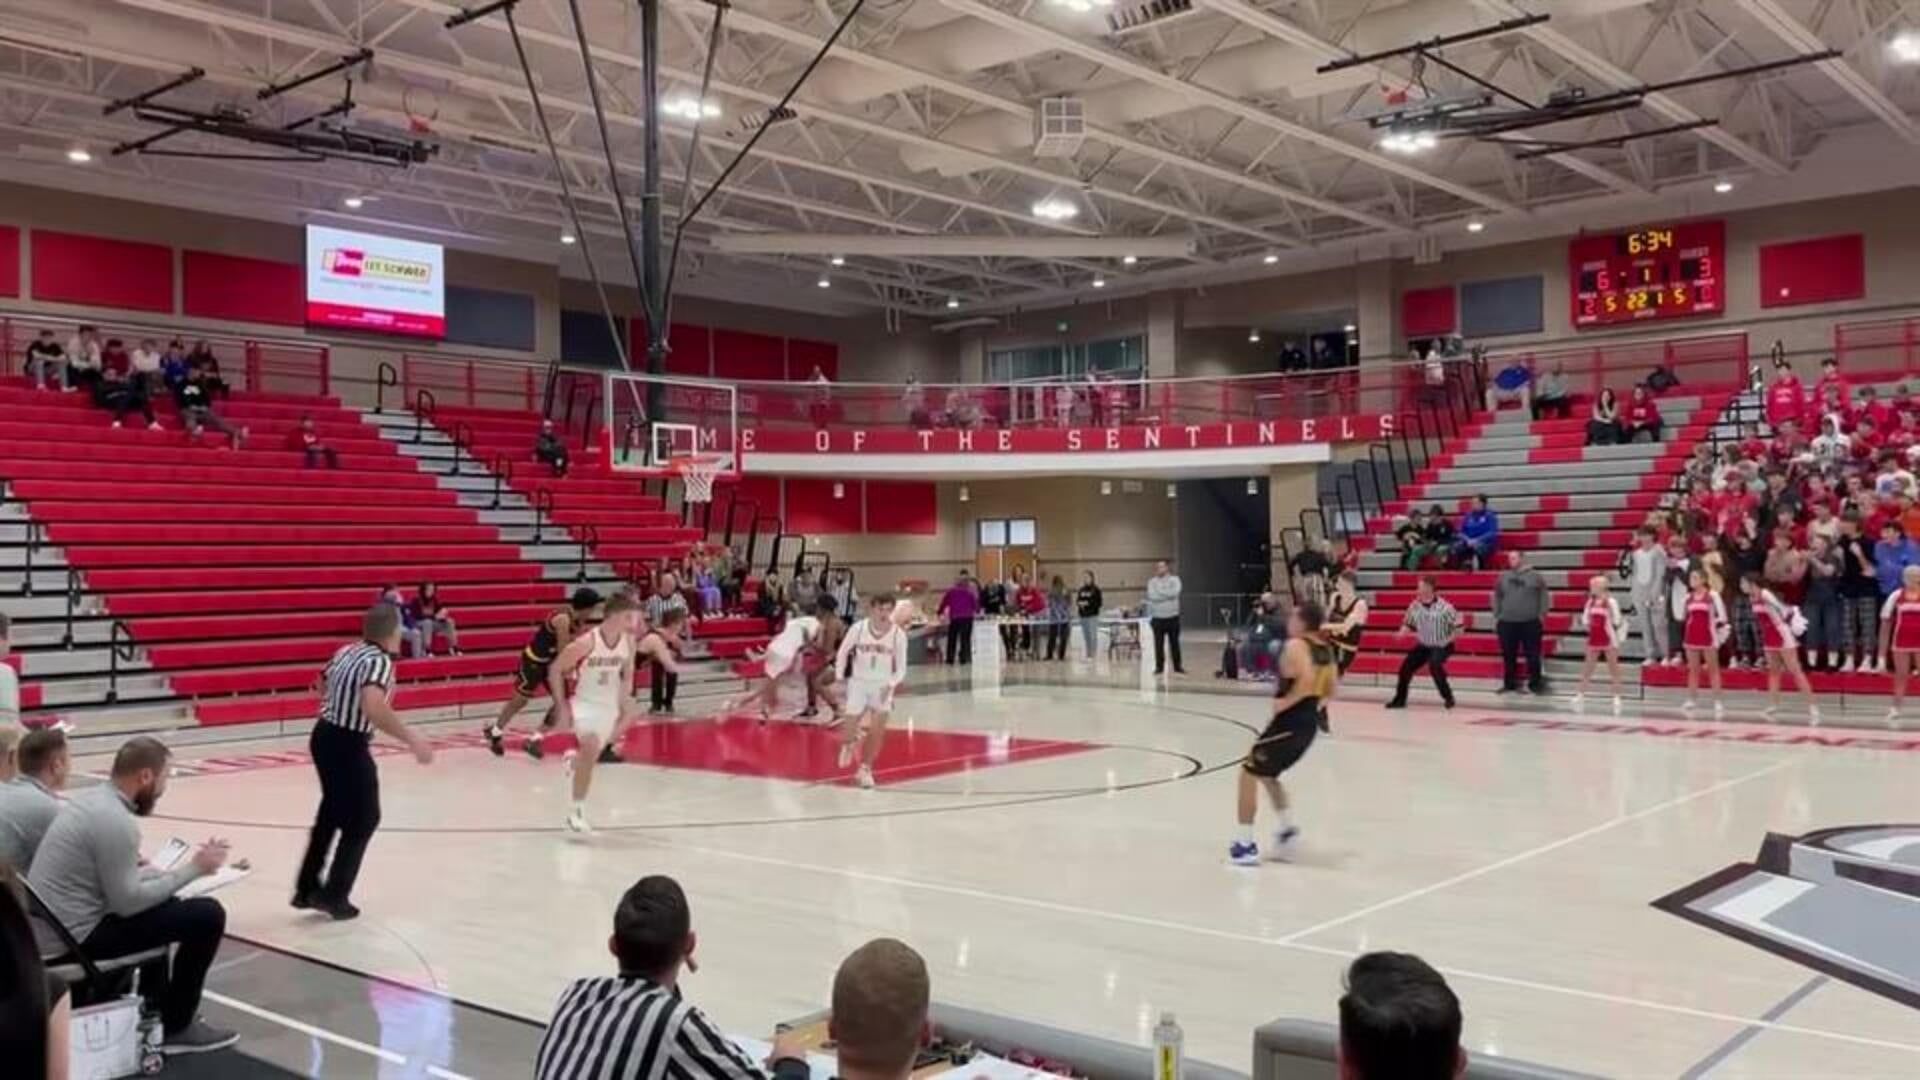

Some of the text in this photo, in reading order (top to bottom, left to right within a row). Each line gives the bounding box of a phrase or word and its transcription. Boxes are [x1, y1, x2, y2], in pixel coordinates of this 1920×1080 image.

[1628, 230, 1673, 254] 6:34
[1643, 268, 1650, 282] 1
[1699, 258, 1711, 279] 3
[1597, 272, 1610, 289] 6
[1605, 296, 1617, 313] 5
[1674, 288, 1687, 305] 5
[815, 431, 866, 451] OF
[918, 430, 1012, 451] THE
[1067, 415, 1394, 450] SENTINELS
